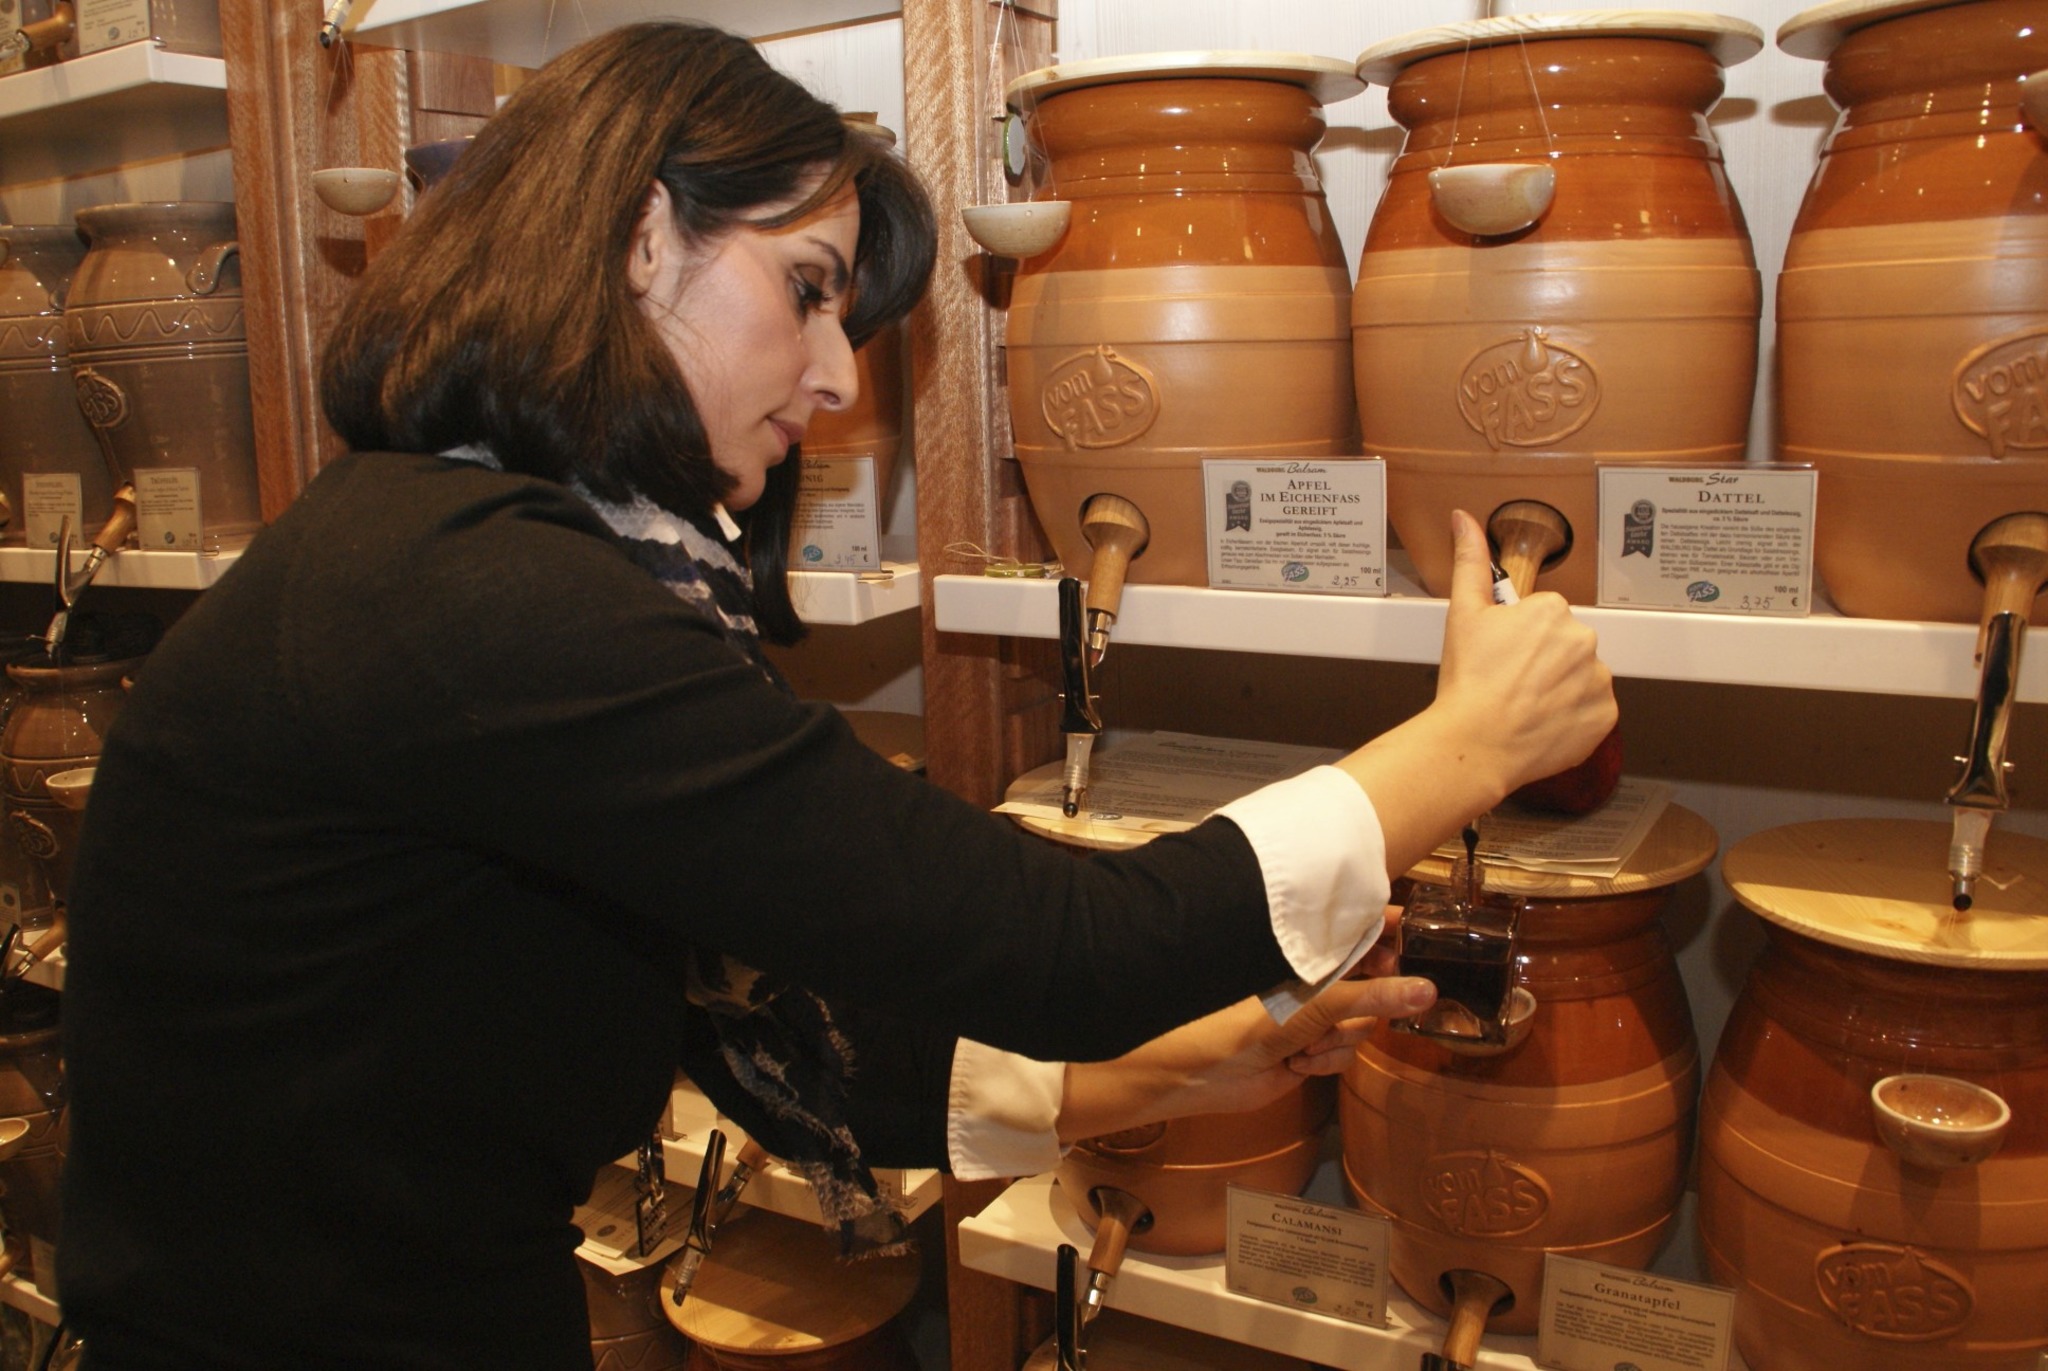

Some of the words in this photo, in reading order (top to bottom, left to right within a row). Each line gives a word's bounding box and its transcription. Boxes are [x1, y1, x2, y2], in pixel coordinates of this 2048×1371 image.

[1462, 358, 1523, 404] vom
[1046, 368, 1094, 410] vom
[1480, 357, 1588, 451] FASS
[1060, 375, 1146, 453] FASS
[1286, 462, 1327, 474] Balsam
[1287, 479, 1332, 491] APFEL
[1705, 472, 1739, 486] Star
[1260, 492, 1275, 502] IM
[1279, 491, 1361, 504] EICHENFASS
[1698, 490, 1766, 504] DATTEL
[1282, 505, 1338, 516] GEREIFT
[1331, 575, 1359, 589] 2,25
[1375, 577, 1381, 587] €
[1774, 585, 1787, 593] 100
[1789, 585, 1799, 594] ml
[1740, 595, 1775, 612] 3,75
[1791, 597, 1798, 607] €
[1271, 1212, 1343, 1236] CALAMANSI
[1593, 1282, 1682, 1311] Granatapfel
